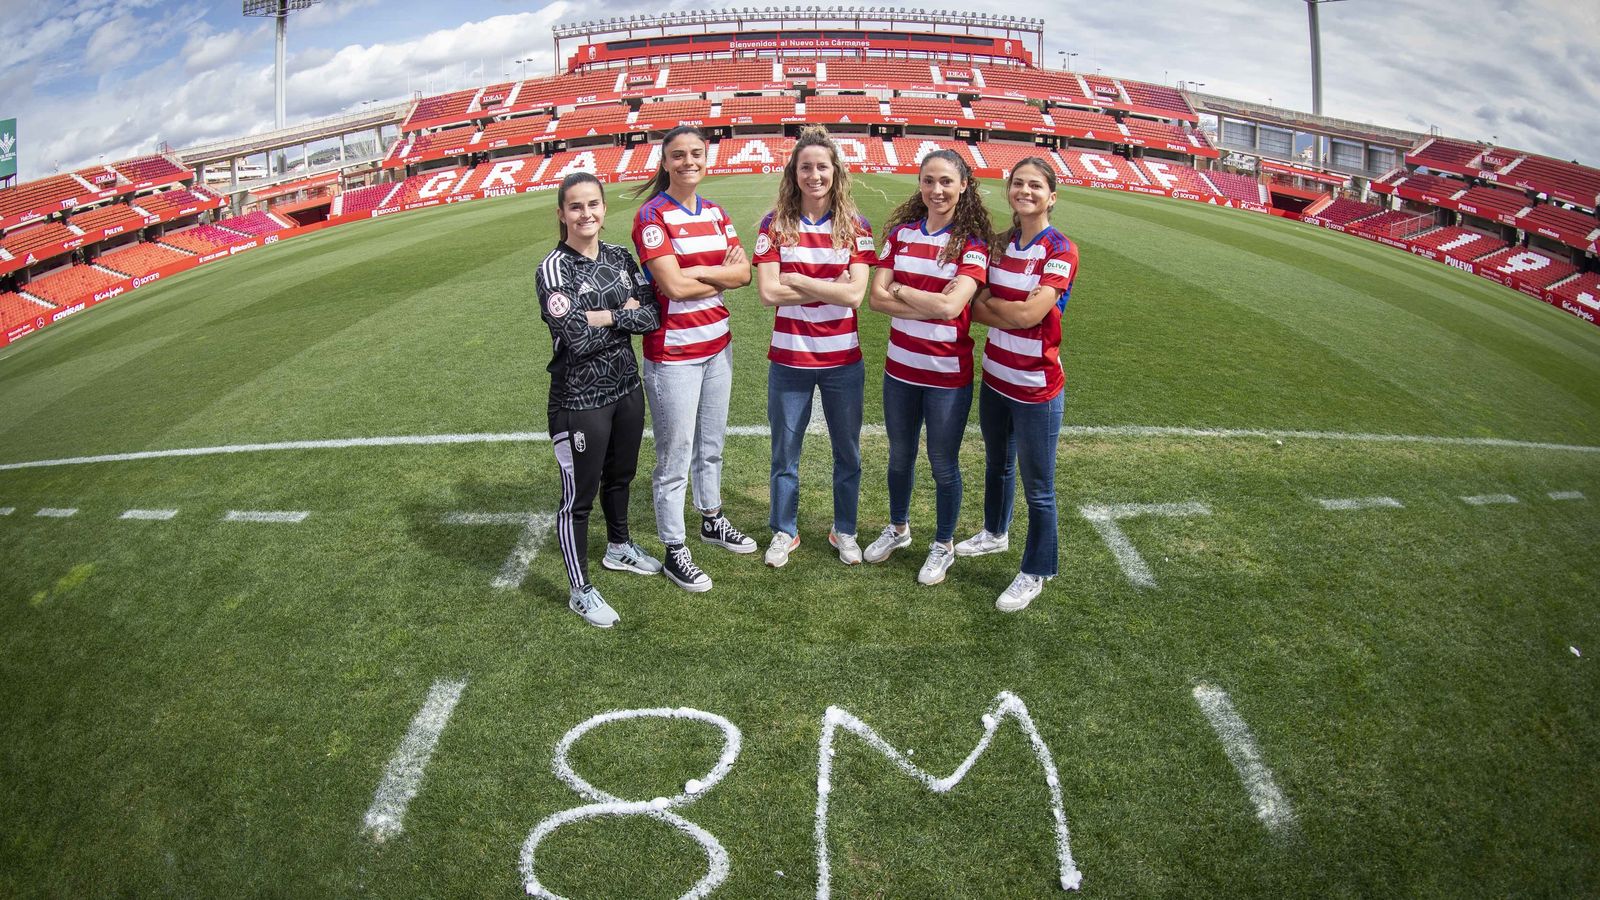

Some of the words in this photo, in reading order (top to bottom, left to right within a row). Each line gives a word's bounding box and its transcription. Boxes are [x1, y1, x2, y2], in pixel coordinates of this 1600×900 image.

[729, 41, 777, 49] Bienvenidos
[1095, 86, 1117, 94] IDEAL
[484, 187, 517, 198] PULEVA
[104, 226, 124, 236] PULEVA
[966, 253, 985, 263] OLIVA
[1047, 262, 1068, 271] OLIVA
[1444, 255, 1474, 274] PULEVA
[140, 272, 160, 284] sorare
[517, 692, 1082, 900] 8M
